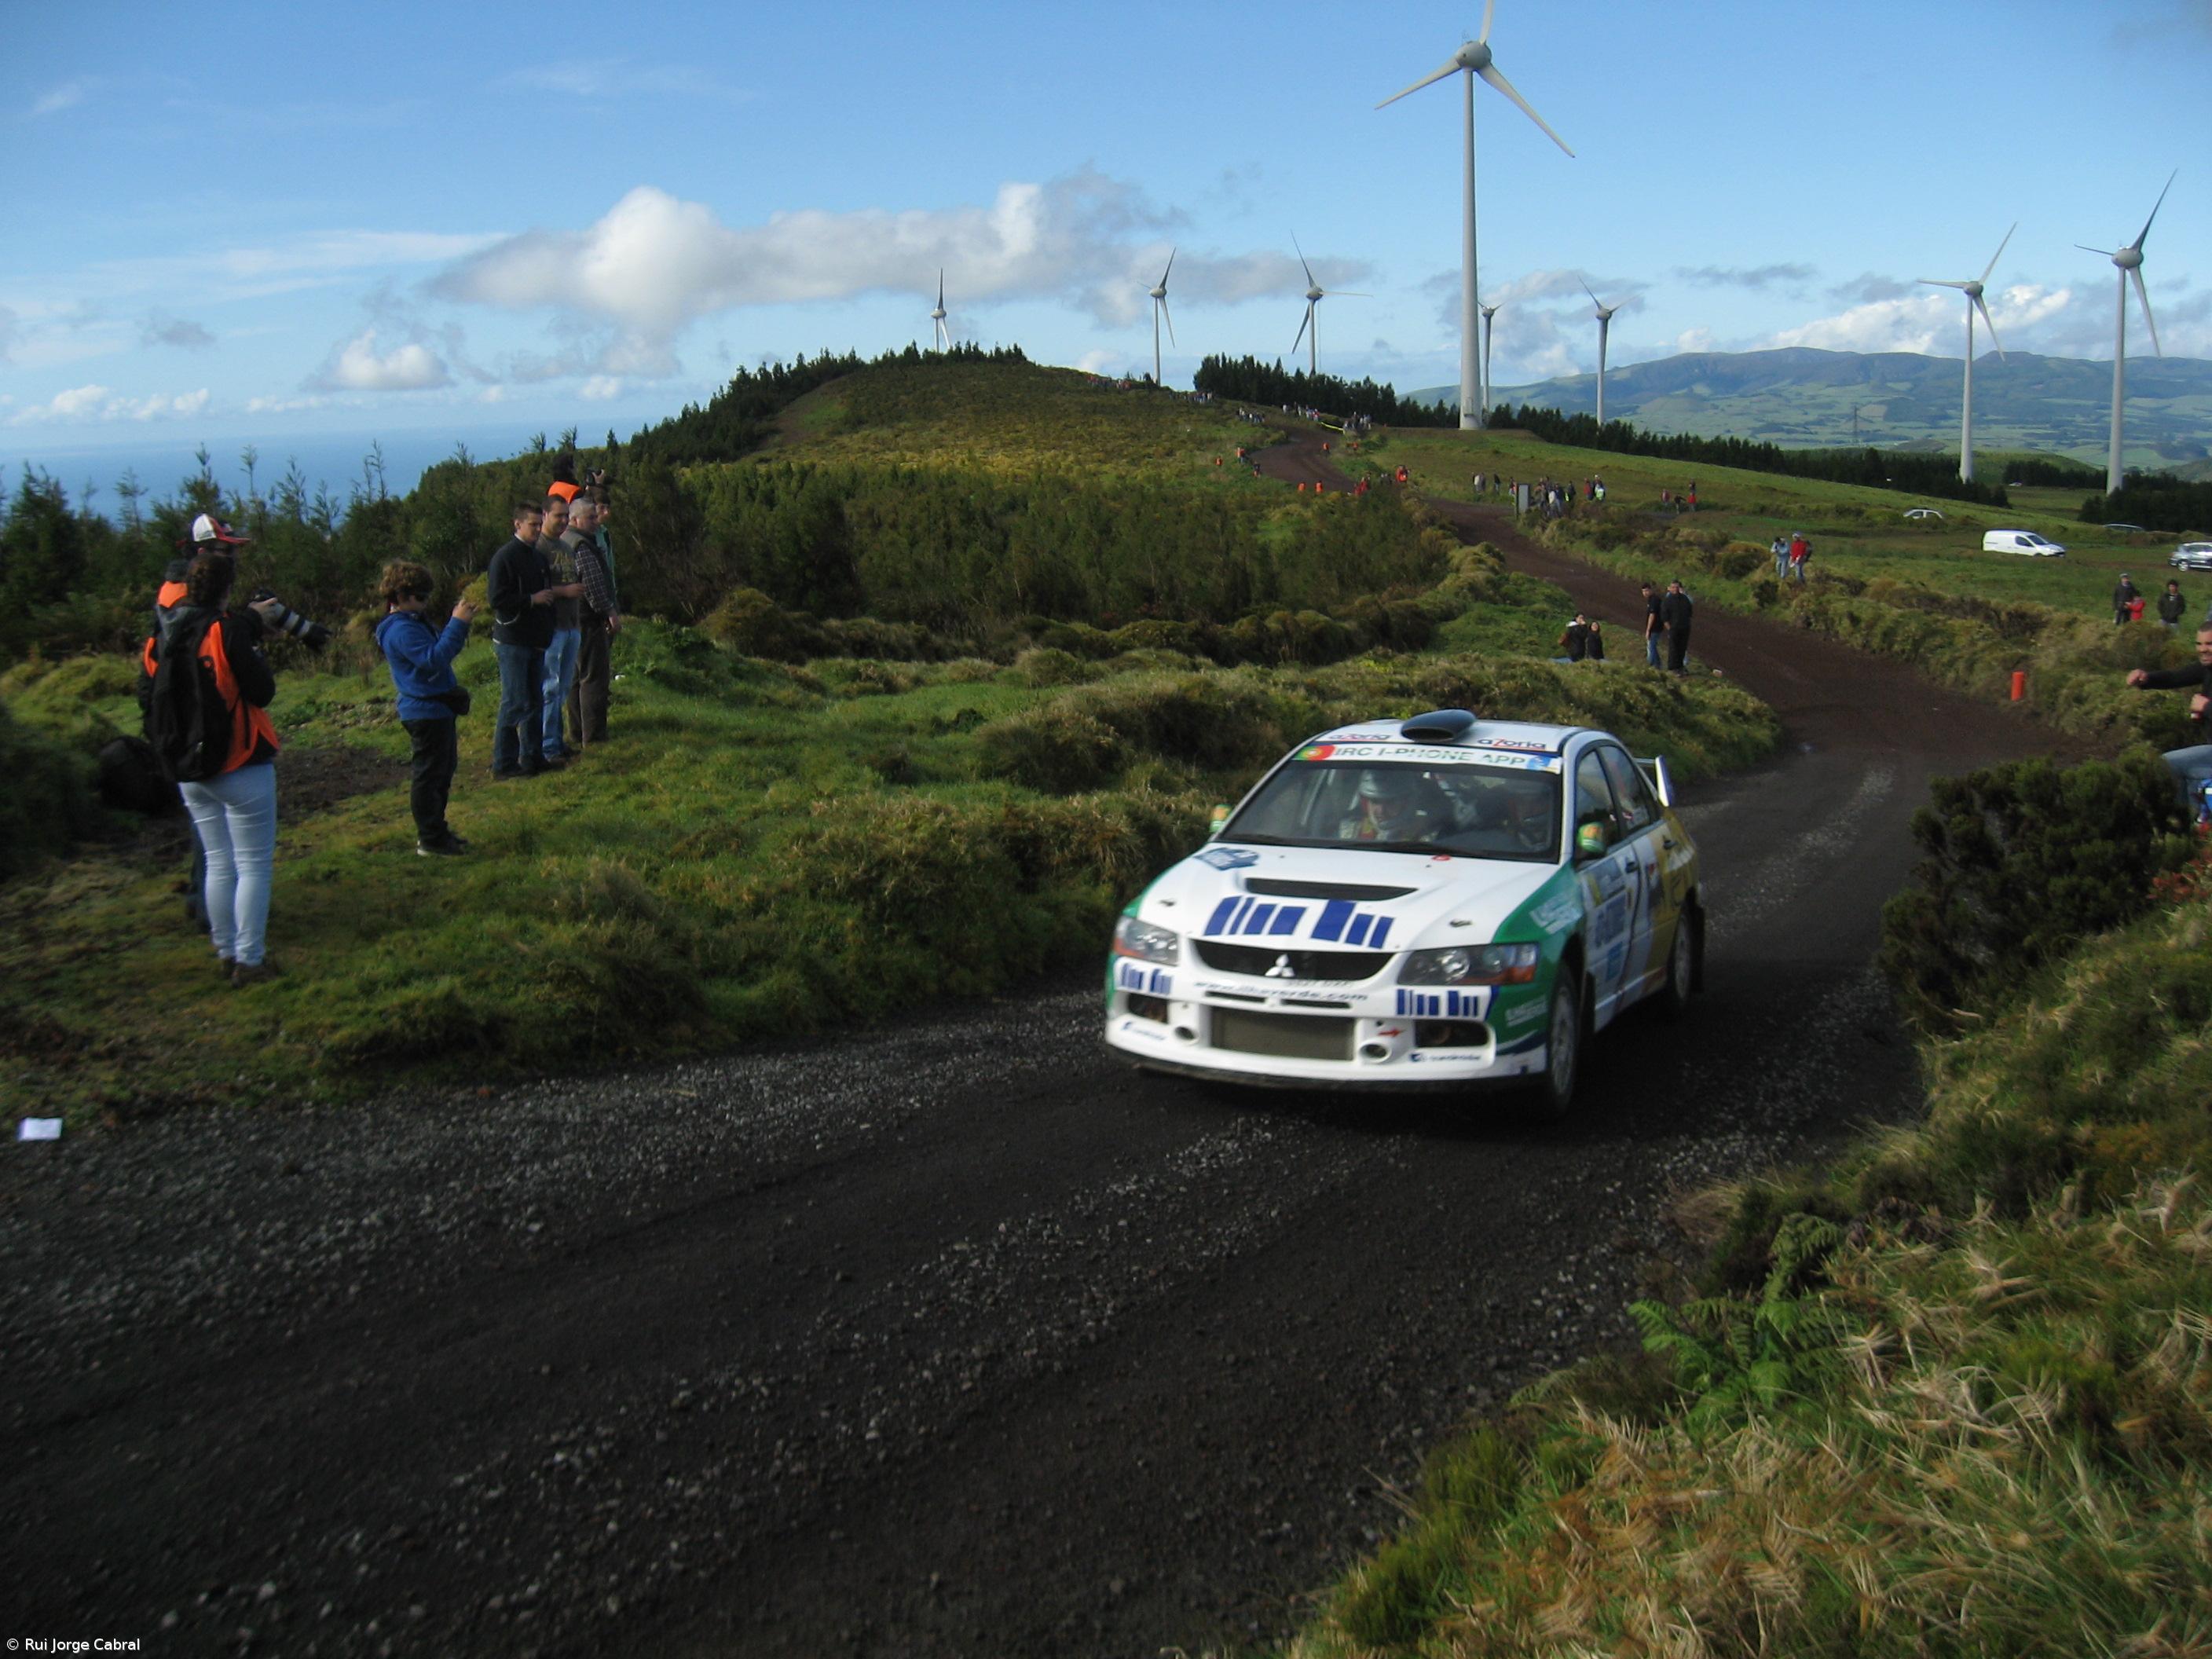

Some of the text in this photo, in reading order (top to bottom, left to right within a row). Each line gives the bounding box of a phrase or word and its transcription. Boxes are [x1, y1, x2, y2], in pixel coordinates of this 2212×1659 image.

[1334, 747, 1526, 765] IRC I-PHONE APP
